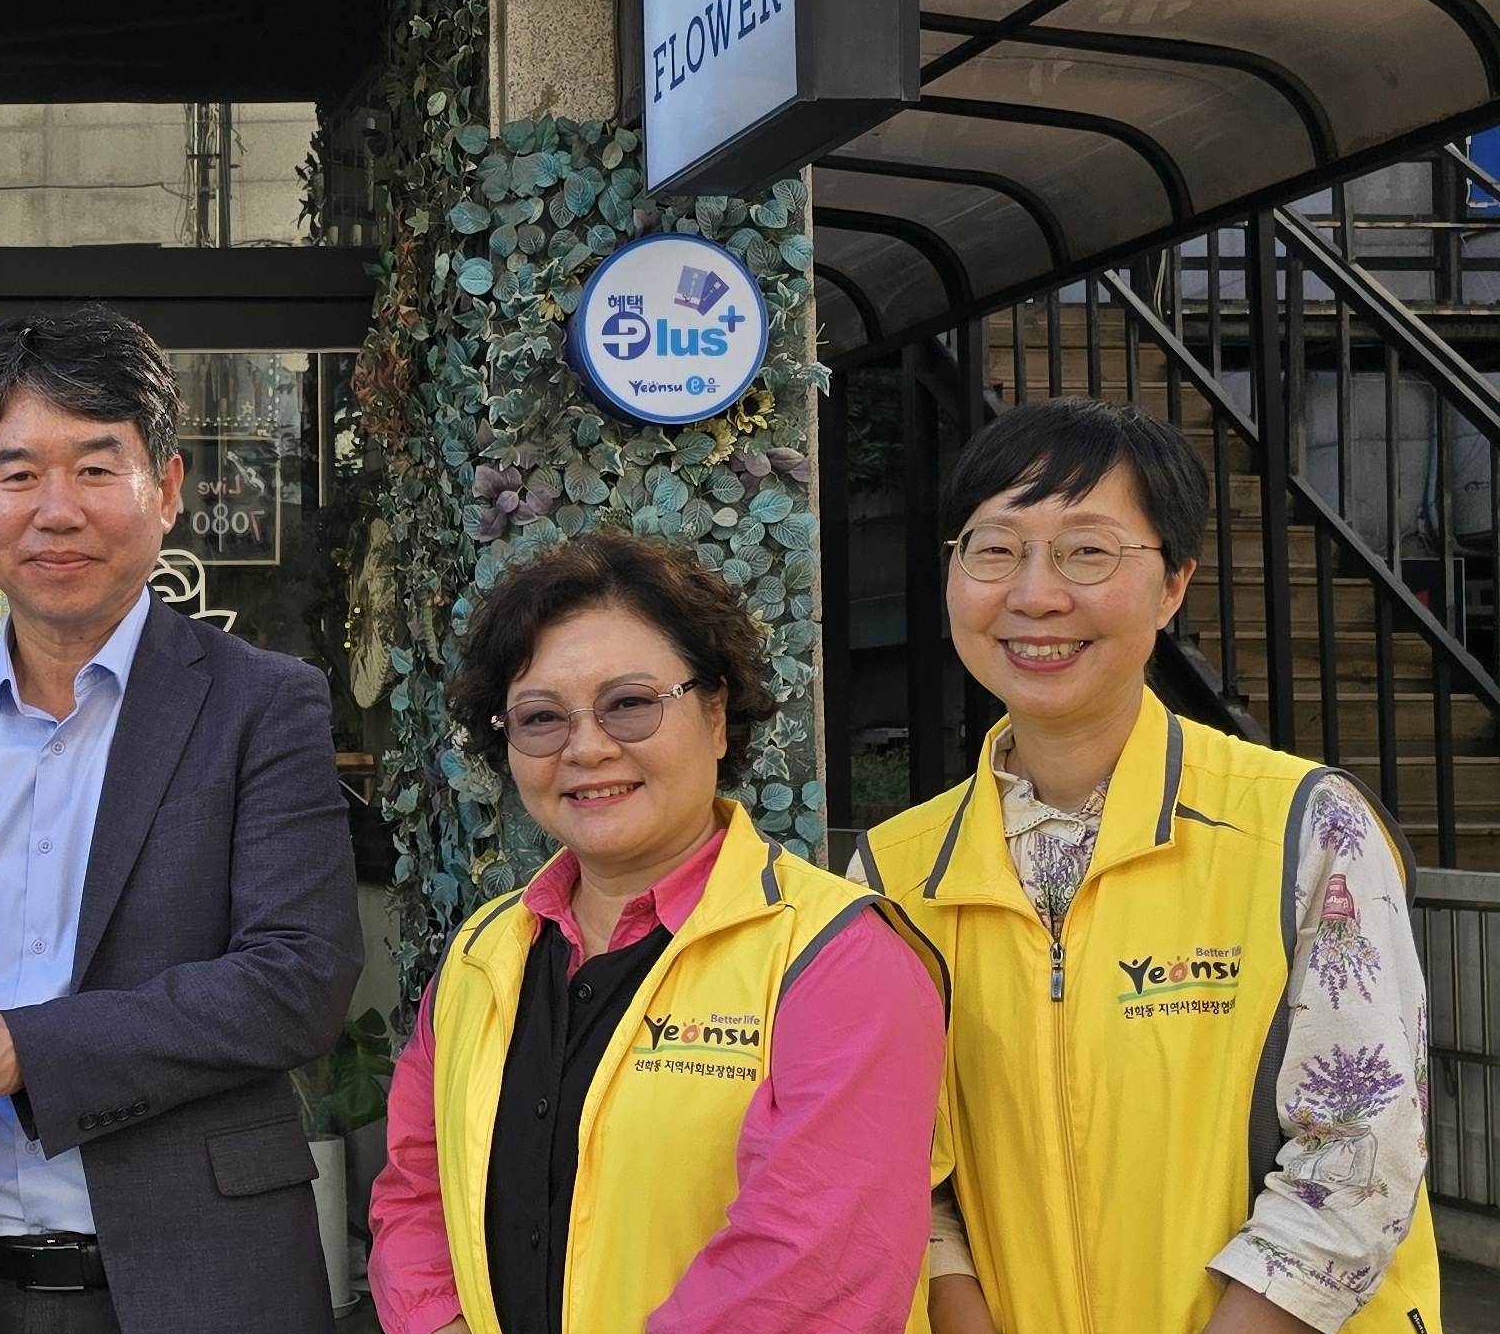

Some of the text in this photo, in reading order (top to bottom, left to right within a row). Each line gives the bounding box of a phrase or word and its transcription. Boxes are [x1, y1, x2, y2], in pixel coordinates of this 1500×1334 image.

[607, 294, 644, 315] 혜택
[628, 379, 683, 397] Yeonsu
[1196, 947, 1230, 958] Better
[1123, 994, 1237, 1020] 선학동 지역사회보장협
[710, 1013, 761, 1026] Better life
[643, 1013, 760, 1051] Yeonsu
[634, 1058, 757, 1082] 선학동 지역사회보장협의체
